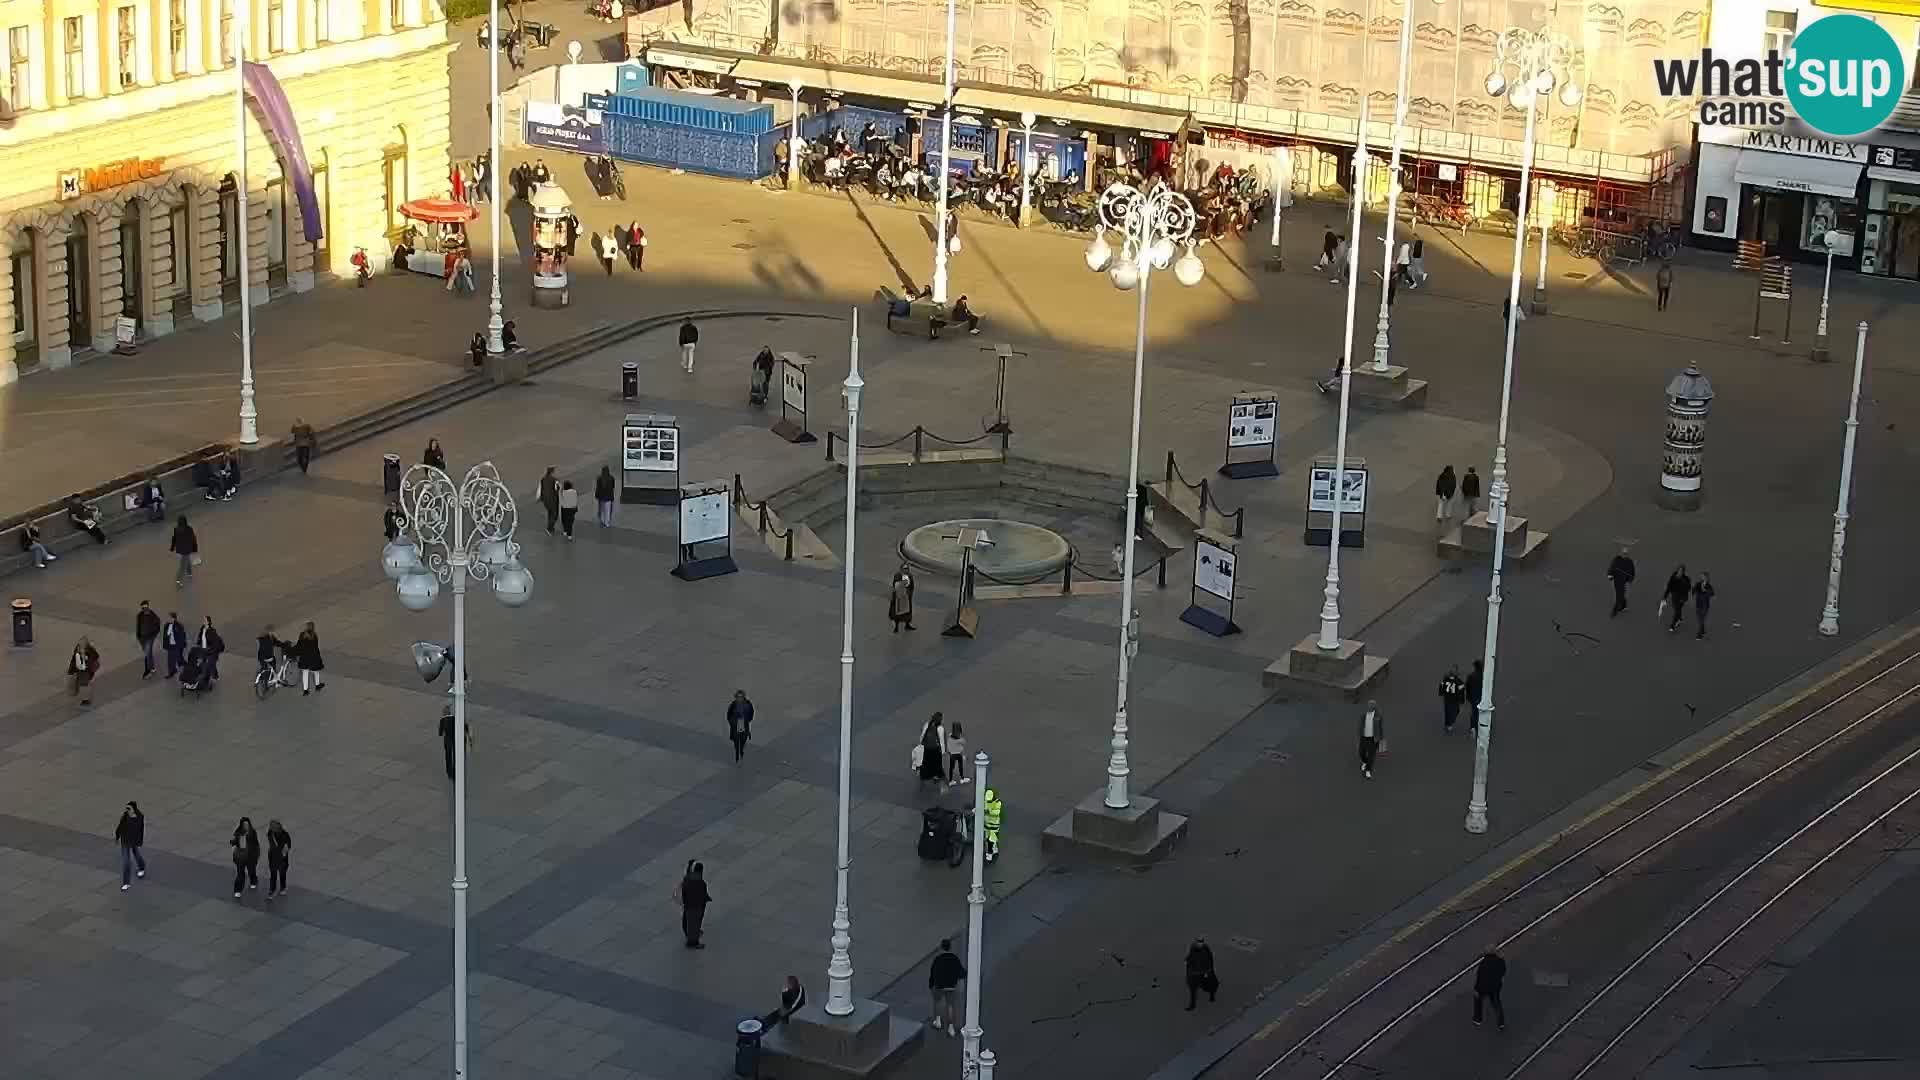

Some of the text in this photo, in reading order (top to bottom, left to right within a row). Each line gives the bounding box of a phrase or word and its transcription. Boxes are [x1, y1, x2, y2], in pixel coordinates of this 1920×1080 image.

[1747, 132, 1857, 159] MARTIMEX
[63, 177, 75, 193] M
[1445, 681, 1456, 694] 74
